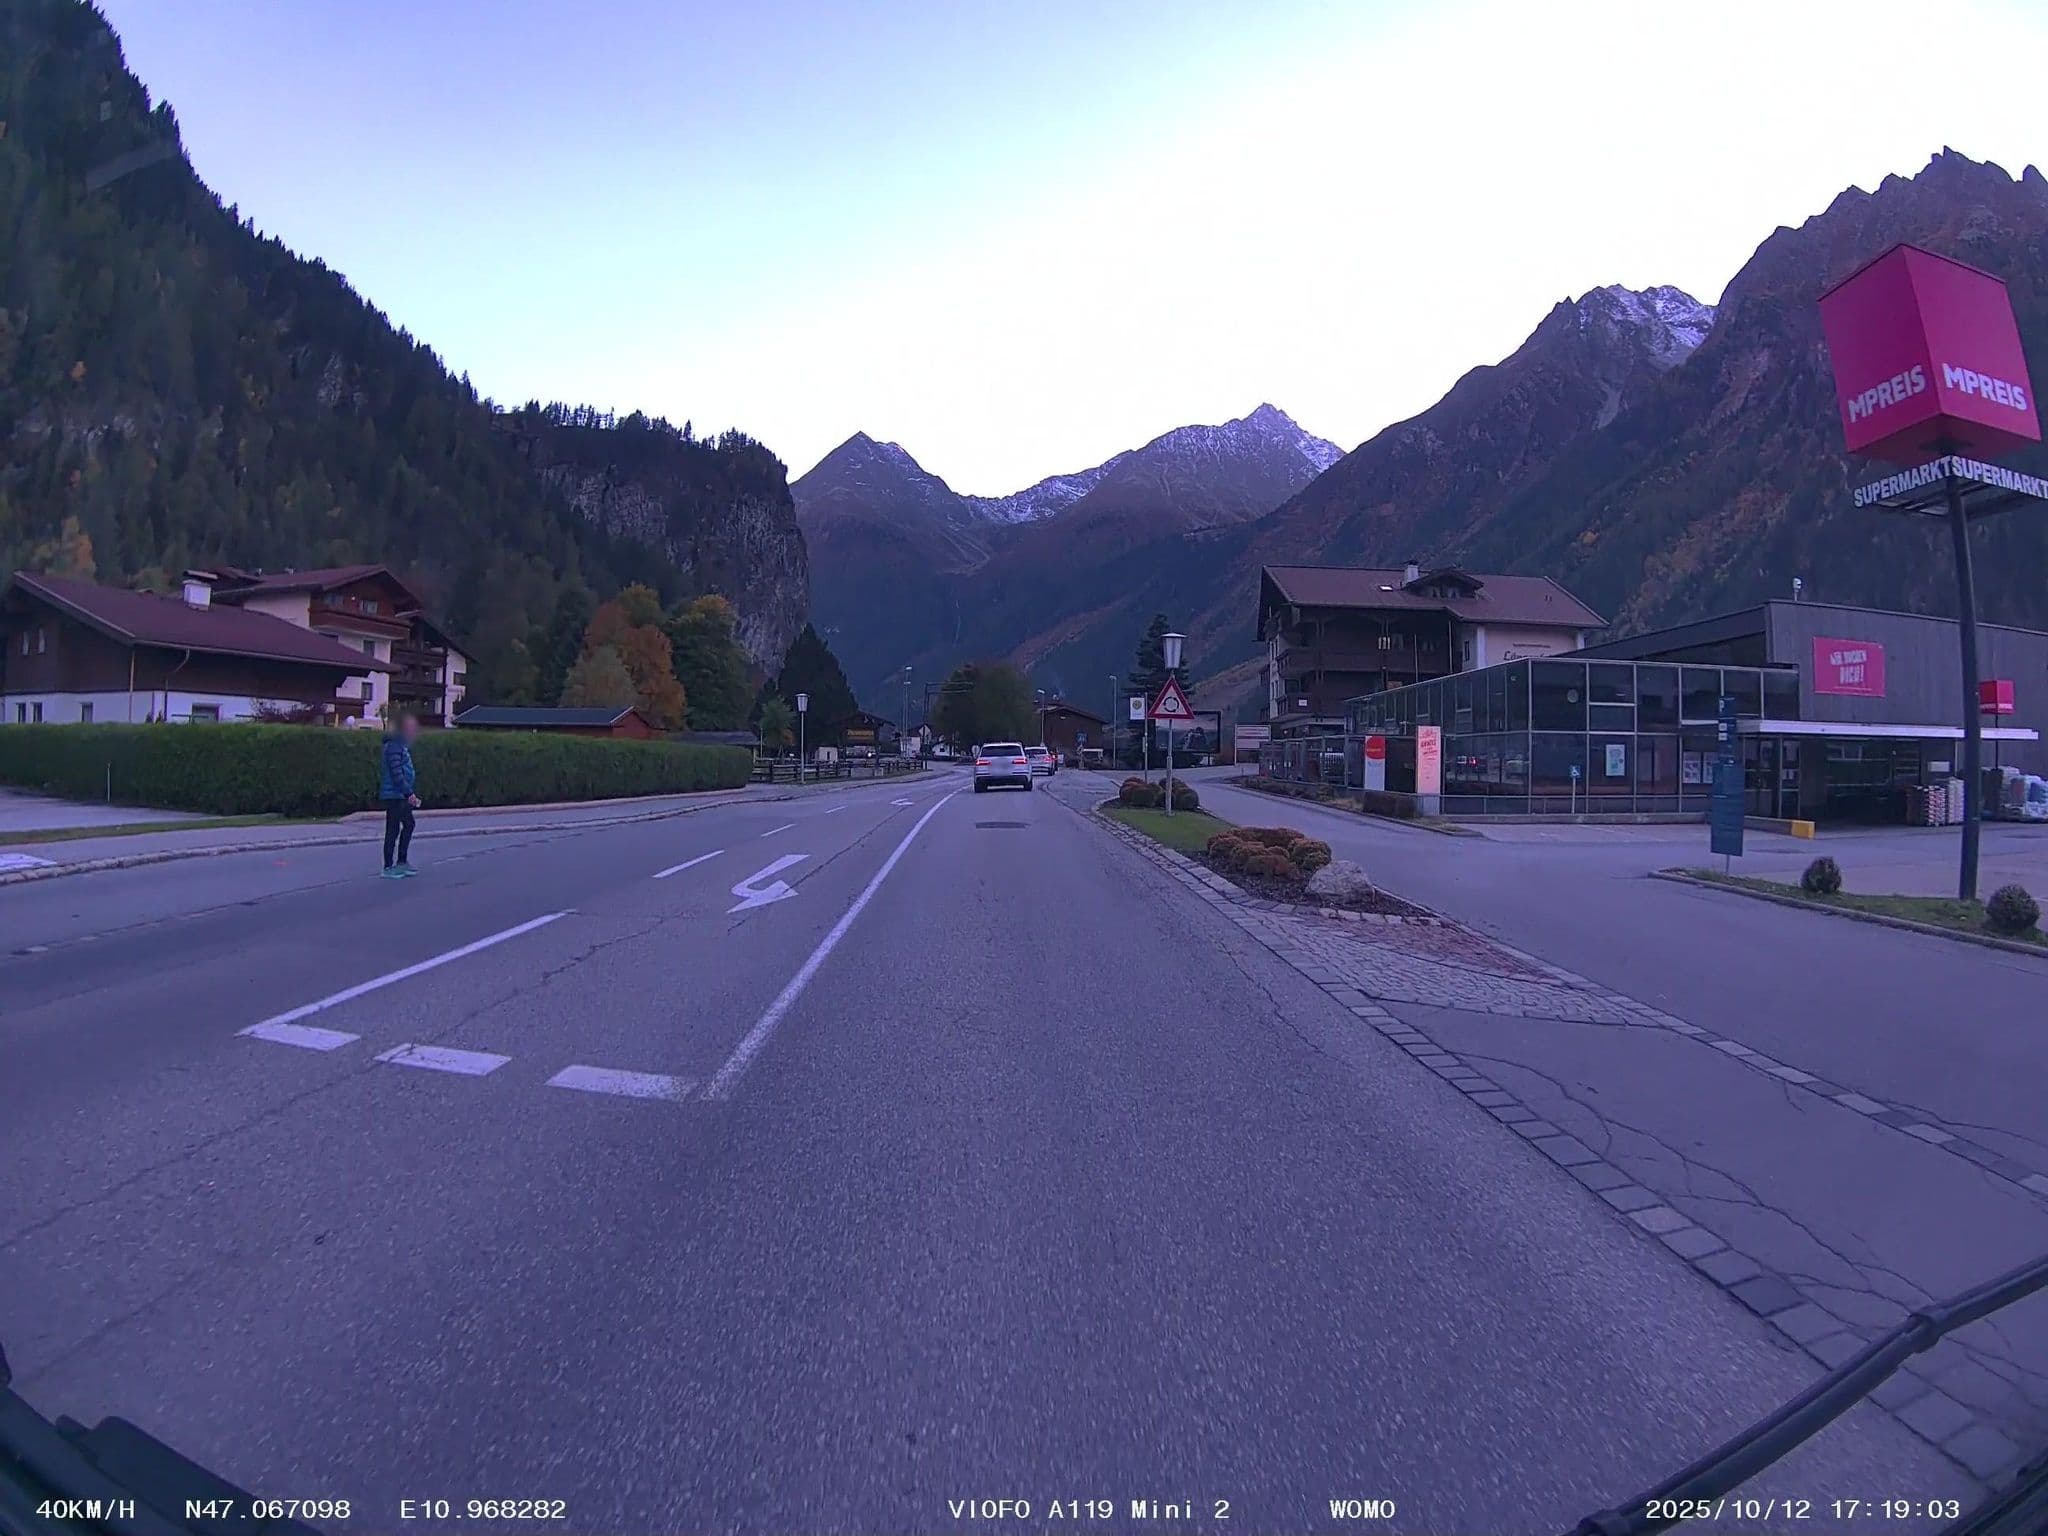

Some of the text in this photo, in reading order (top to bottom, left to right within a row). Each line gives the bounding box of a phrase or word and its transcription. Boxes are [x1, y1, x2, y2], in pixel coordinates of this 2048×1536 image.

[1848, 365, 1926, 423] MPREIS
[1942, 363, 2028, 411] MPREIS
[1854, 456, 1951, 508] SUPERMARKT
[1951, 456, 2048, 500] SUPERMARKT
